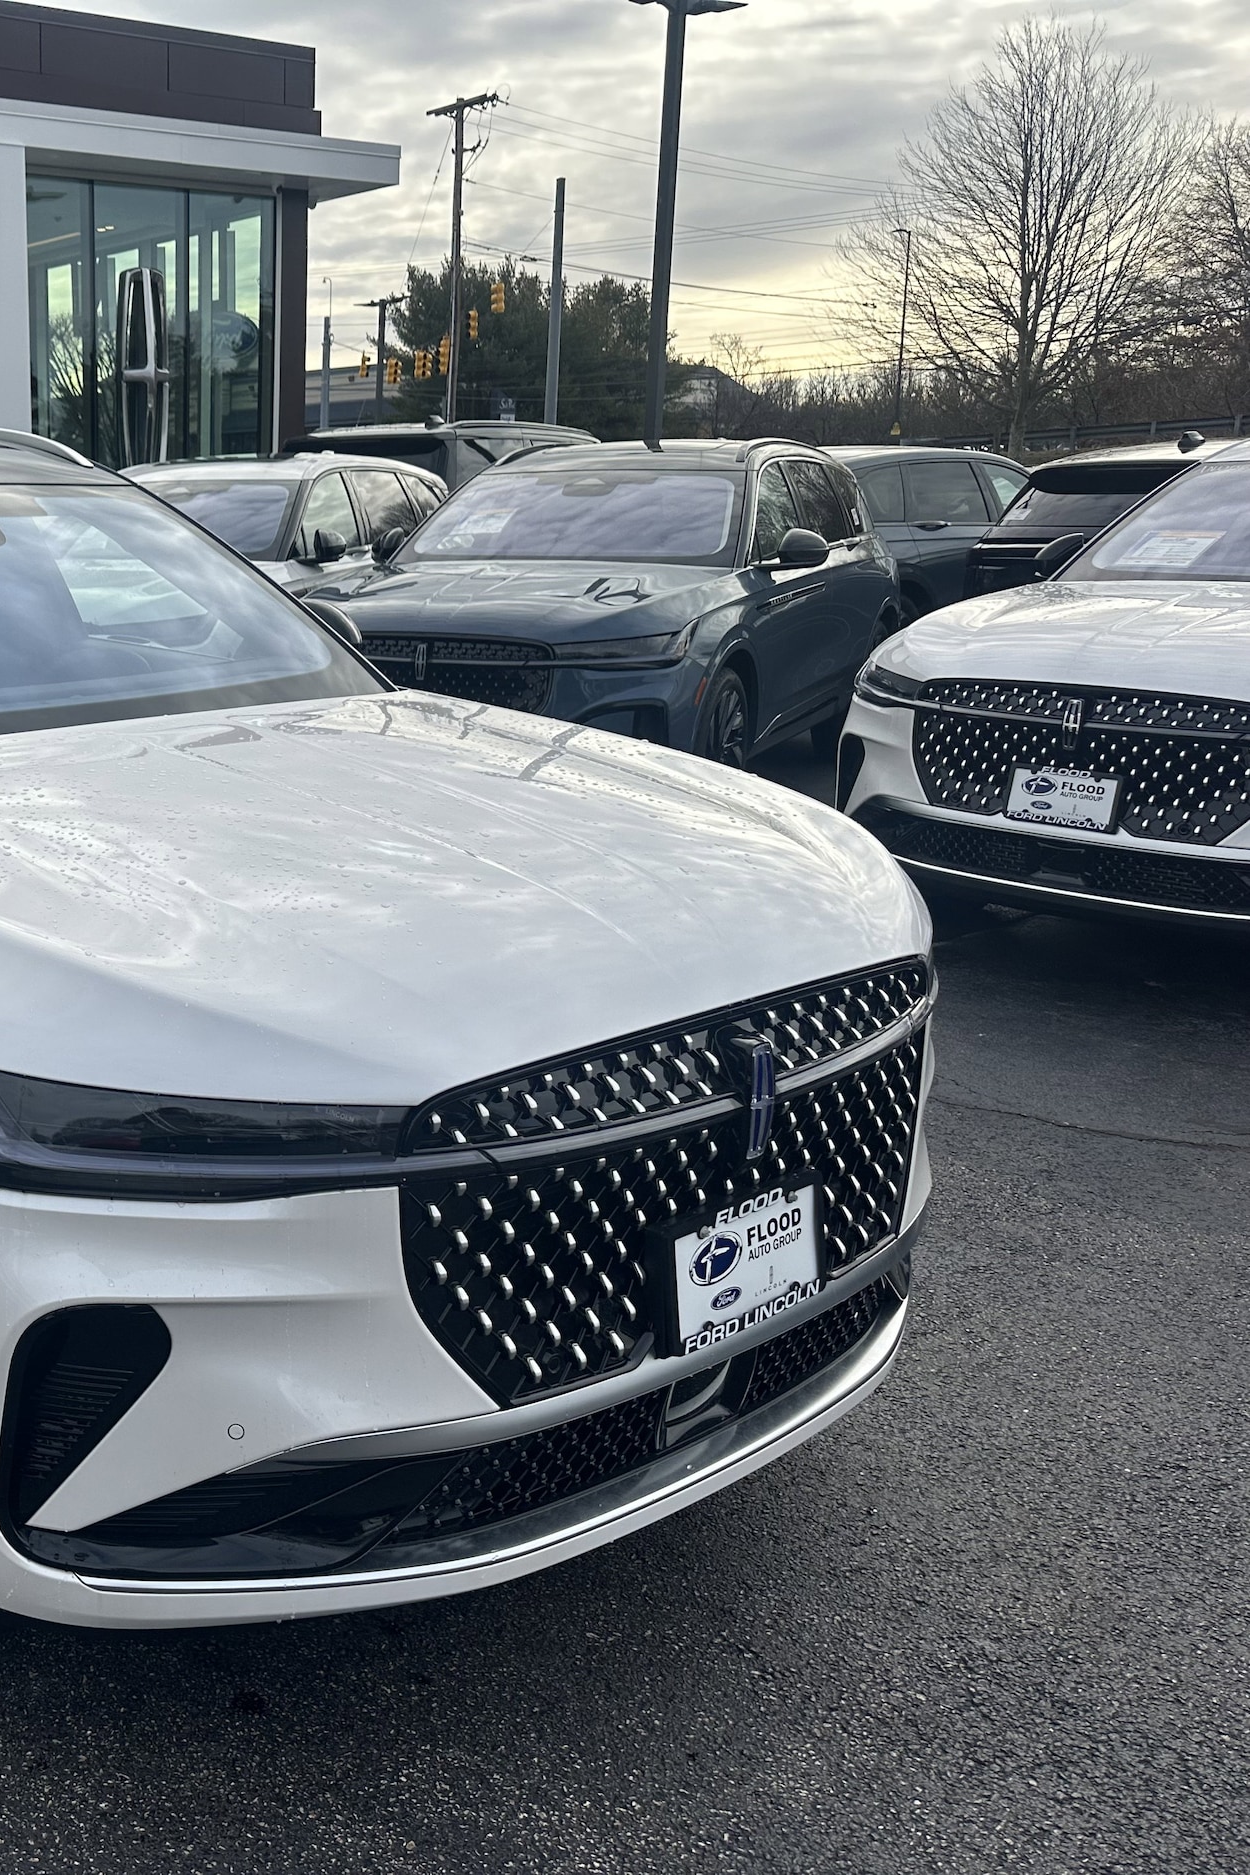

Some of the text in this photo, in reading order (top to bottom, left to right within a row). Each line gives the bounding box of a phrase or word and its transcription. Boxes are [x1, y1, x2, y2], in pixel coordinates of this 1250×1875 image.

[1041, 766, 1091, 778] FLOOD
[1059, 791, 1103, 802] AUTO GROUP
[1061, 781, 1105, 795] FLOOD
[1006, 810, 1106, 831] FORD LINCOLN
[715, 1187, 784, 1228] FLOOD
[747, 1207, 802, 1247] FLOOD
[748, 1228, 802, 1262] AUTO GROUP
[755, 1279, 788, 1297] LINCOLN
[685, 1279, 820, 1355] FORD LINCOLN
